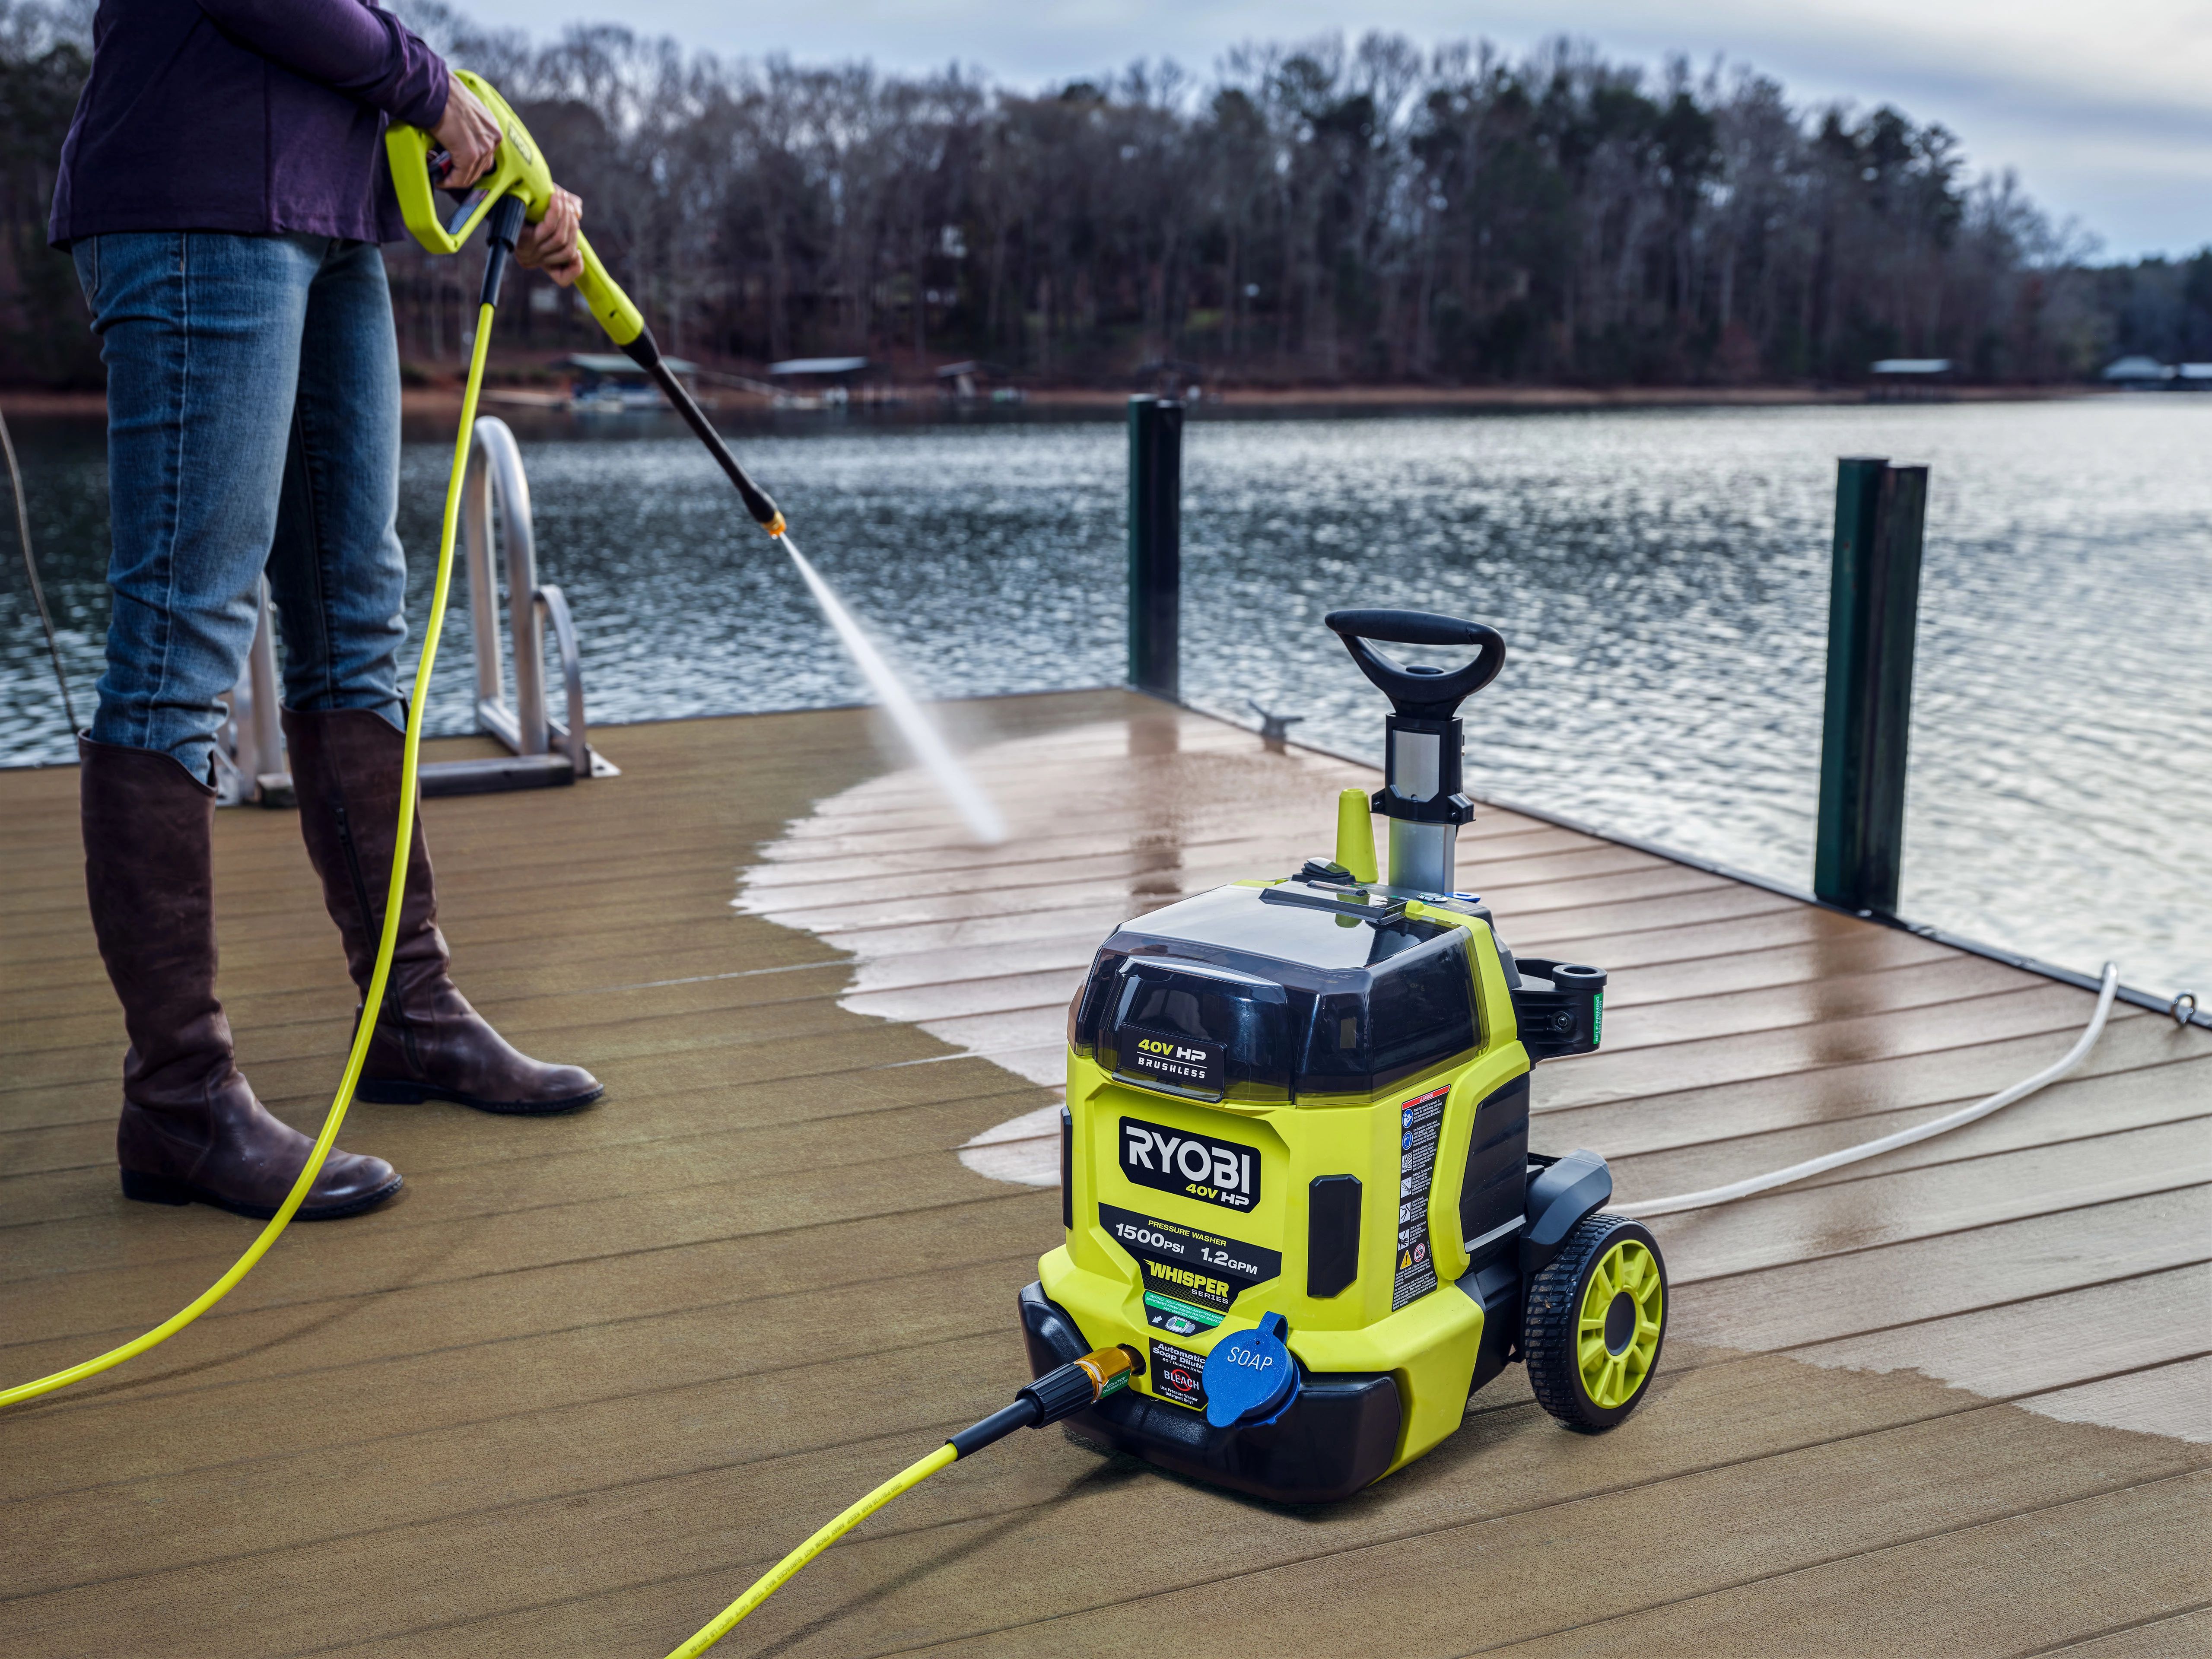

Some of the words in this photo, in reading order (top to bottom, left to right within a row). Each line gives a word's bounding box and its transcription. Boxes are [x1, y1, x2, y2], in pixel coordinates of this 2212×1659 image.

[1138, 1039, 1174, 1055] 40V
[1176, 1046, 1206, 1061] HP
[1138, 1057, 1205, 1079] BRUSHLESS
[1126, 1125, 1250, 1194] RYOBI
[1185, 1183, 1218, 1199] 40V
[1220, 1192, 1249, 1206] HP
[1148, 1220, 1190, 1236] PRESSURE
[1192, 1232, 1227, 1246] WASHER
[1116, 1223, 1184, 1254] 1500PSI
[1201, 1247, 1258, 1275] 1.2GPM
[1143, 1259, 1229, 1297] WHISPER
[1145, 1297, 1166, 1306] SIPHONING
[1192, 1288, 1228, 1304] SERIES
[1165, 1300, 1192, 1310] SELF-PRIMING
[1153, 1347, 1177, 1360] Soap
[1157, 1343, 1206, 1364] Automatic
[1227, 1347, 1273, 1371] SOAP
[1173, 1361, 1189, 1370] Dilution
[1103, 1379, 1128, 1394] SELF-PRIMING
[1106, 1376, 1126, 1389] ADAPTOR
[1164, 1370, 1199, 1390] BLEACH
[1165, 1391, 1183, 1401] Detergent
[1168, 1388, 1184, 1397] Pressure
[1184, 1393, 1198, 1402] Washer
[891, 1482, 902, 1493] 2000
[861, 1504, 873, 1513] BAR
[847, 1512, 861, 1524] KEEP
[831, 1522, 845, 1536] AWAY
[814, 1534, 830, 1549] FROM
[804, 1547, 815, 1558] HOT
[776, 1556, 803, 1580] SURFACES
[764, 1579, 776, 1591] MAX
[750, 1590, 764, 1604] TEMP
